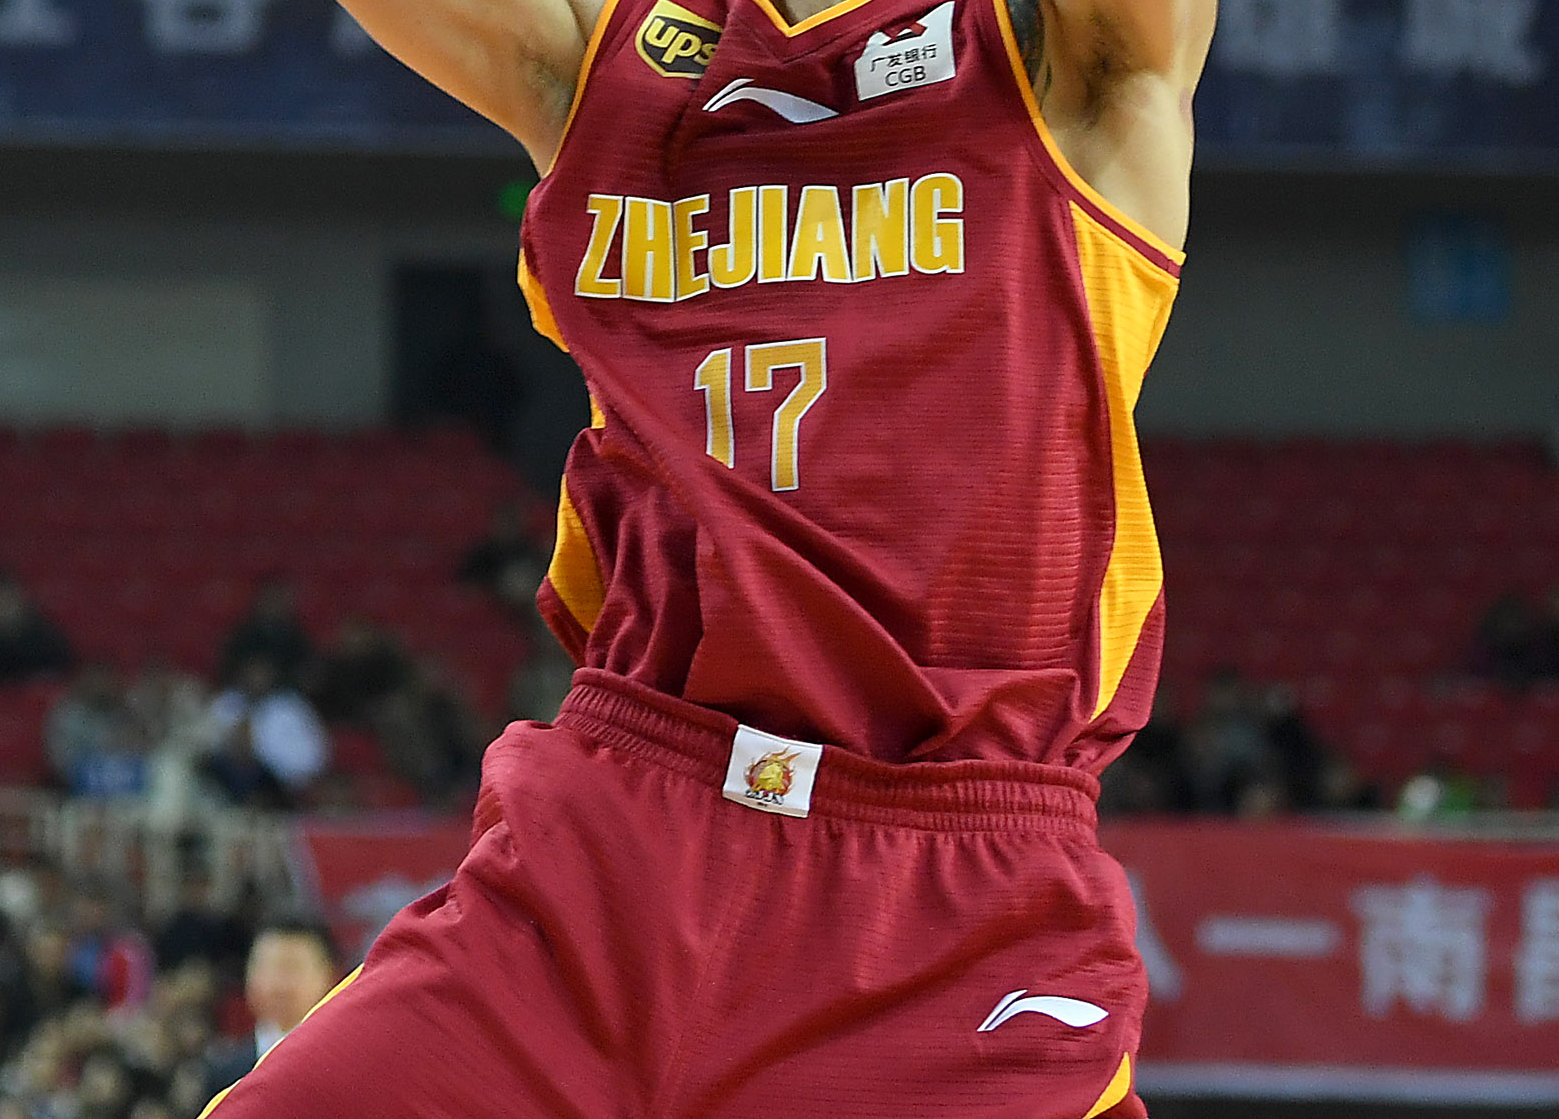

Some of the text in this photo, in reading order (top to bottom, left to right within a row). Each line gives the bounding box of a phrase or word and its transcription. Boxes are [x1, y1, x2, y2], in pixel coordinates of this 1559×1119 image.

[870, 43, 937, 72] 广发银行
[885, 65, 926, 87] CGB
[575, 172, 964, 303] ZHEJIANG
[694, 337, 827, 492] 17
